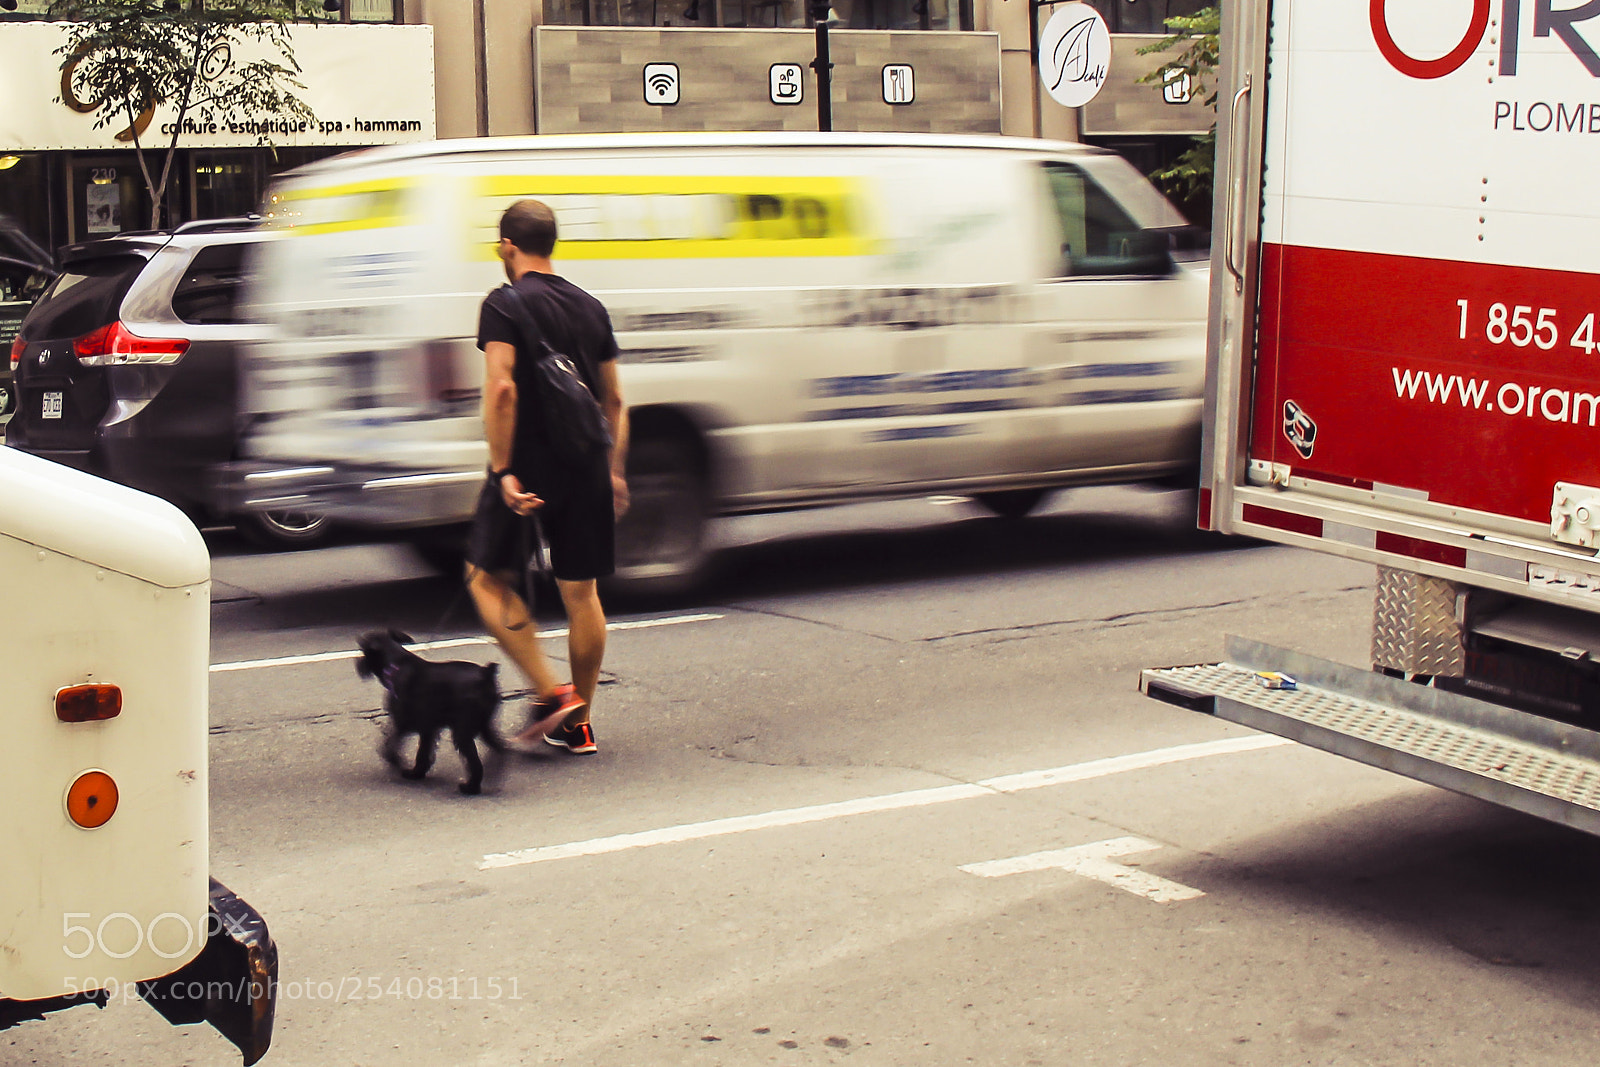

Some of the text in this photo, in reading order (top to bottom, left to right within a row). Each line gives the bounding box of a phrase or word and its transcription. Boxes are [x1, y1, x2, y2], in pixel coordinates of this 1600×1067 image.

[319, 120, 342, 136] spa
[354, 116, 421, 132] hammam
[92, 167, 117, 181] 230
[1456, 299, 1600, 355] 1 855 4
